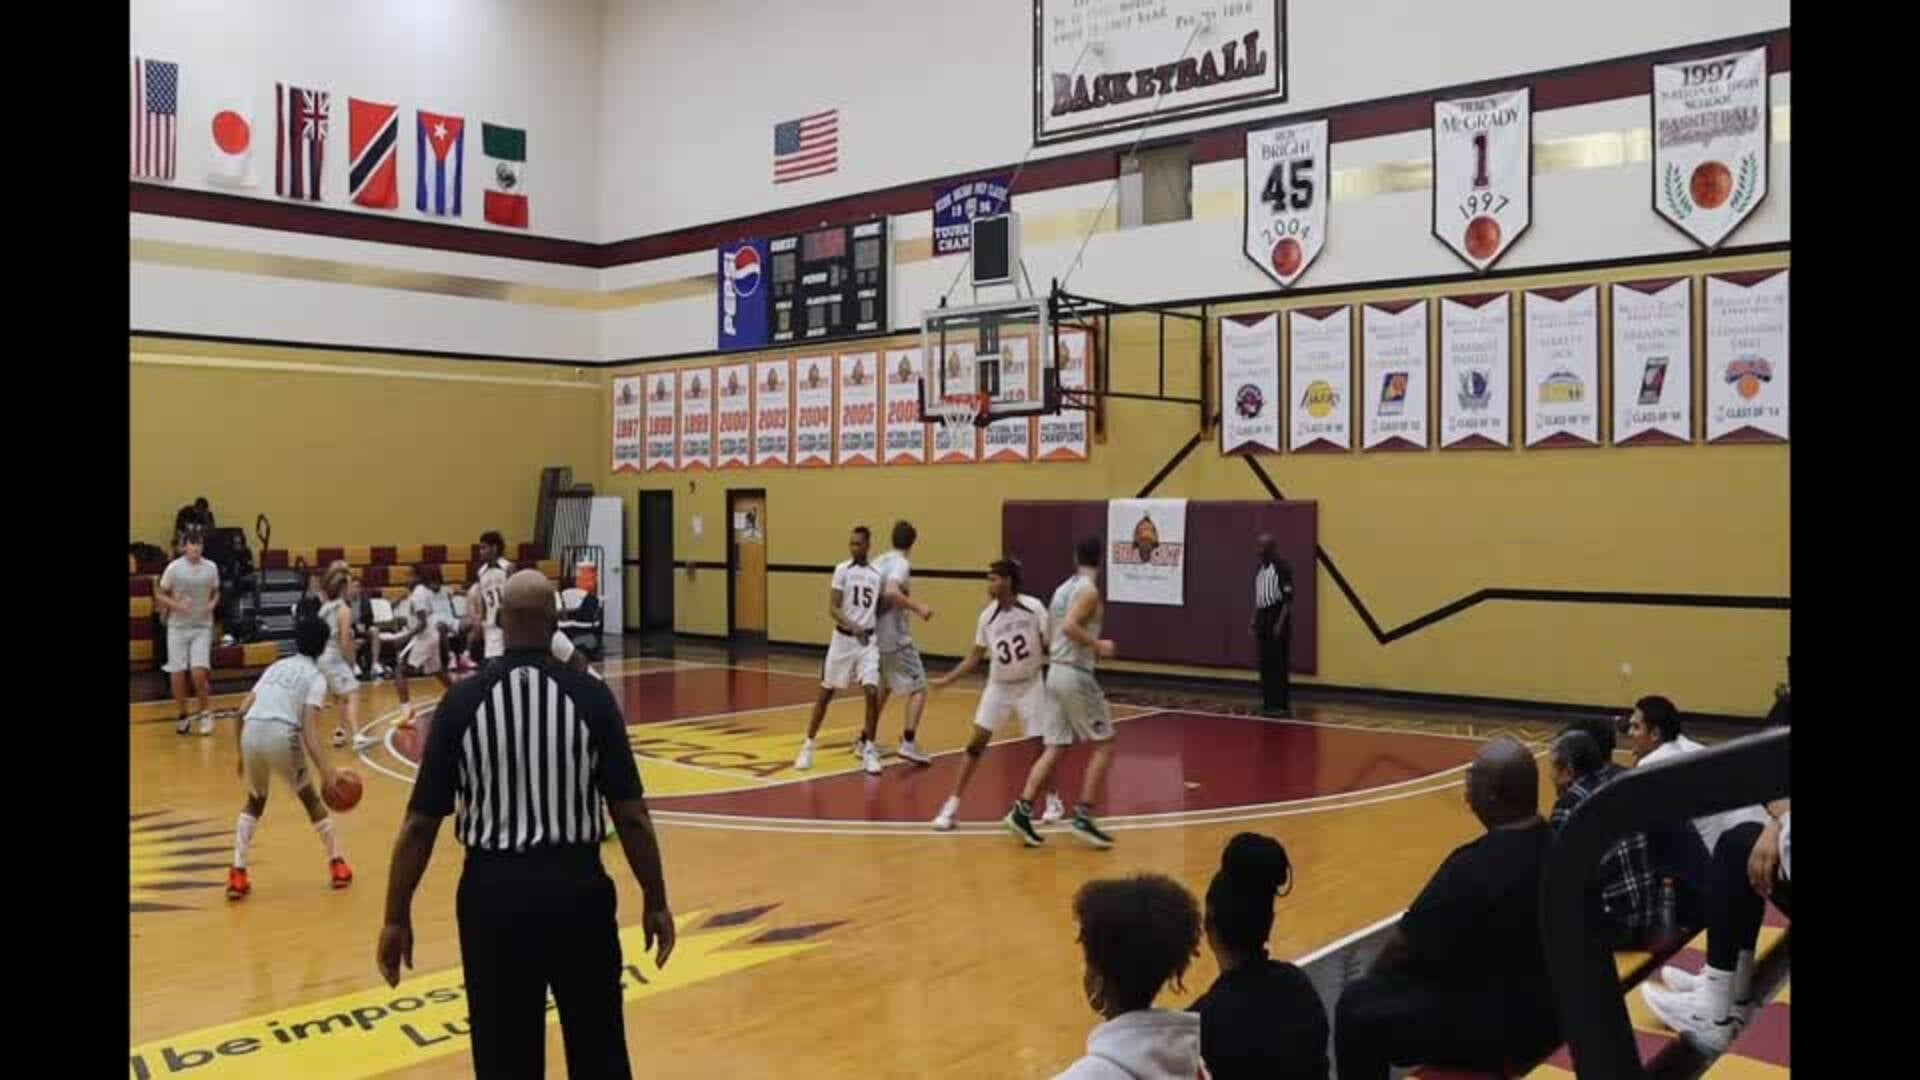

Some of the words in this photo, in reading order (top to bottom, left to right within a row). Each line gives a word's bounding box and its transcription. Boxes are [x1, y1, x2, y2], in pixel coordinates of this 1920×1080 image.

[1051, 30, 1267, 117] BASKETBALL
[1682, 58, 1738, 87] 1997
[1261, 141, 1311, 160] BRIGHT
[1474, 133, 1489, 188] 1
[1261, 160, 1313, 211] 45
[1459, 191, 1509, 220] 1997
[936, 223, 970, 239] TOURN
[938, 237, 970, 251] CHAM
[1261, 218, 1311, 246] 2004
[723, 252, 736, 336] PEPSI
[853, 586, 873, 608] 15
[996, 634, 1029, 665] 32
[161, 1036, 261, 1073] be
[267, 983, 467, 1045] impos
